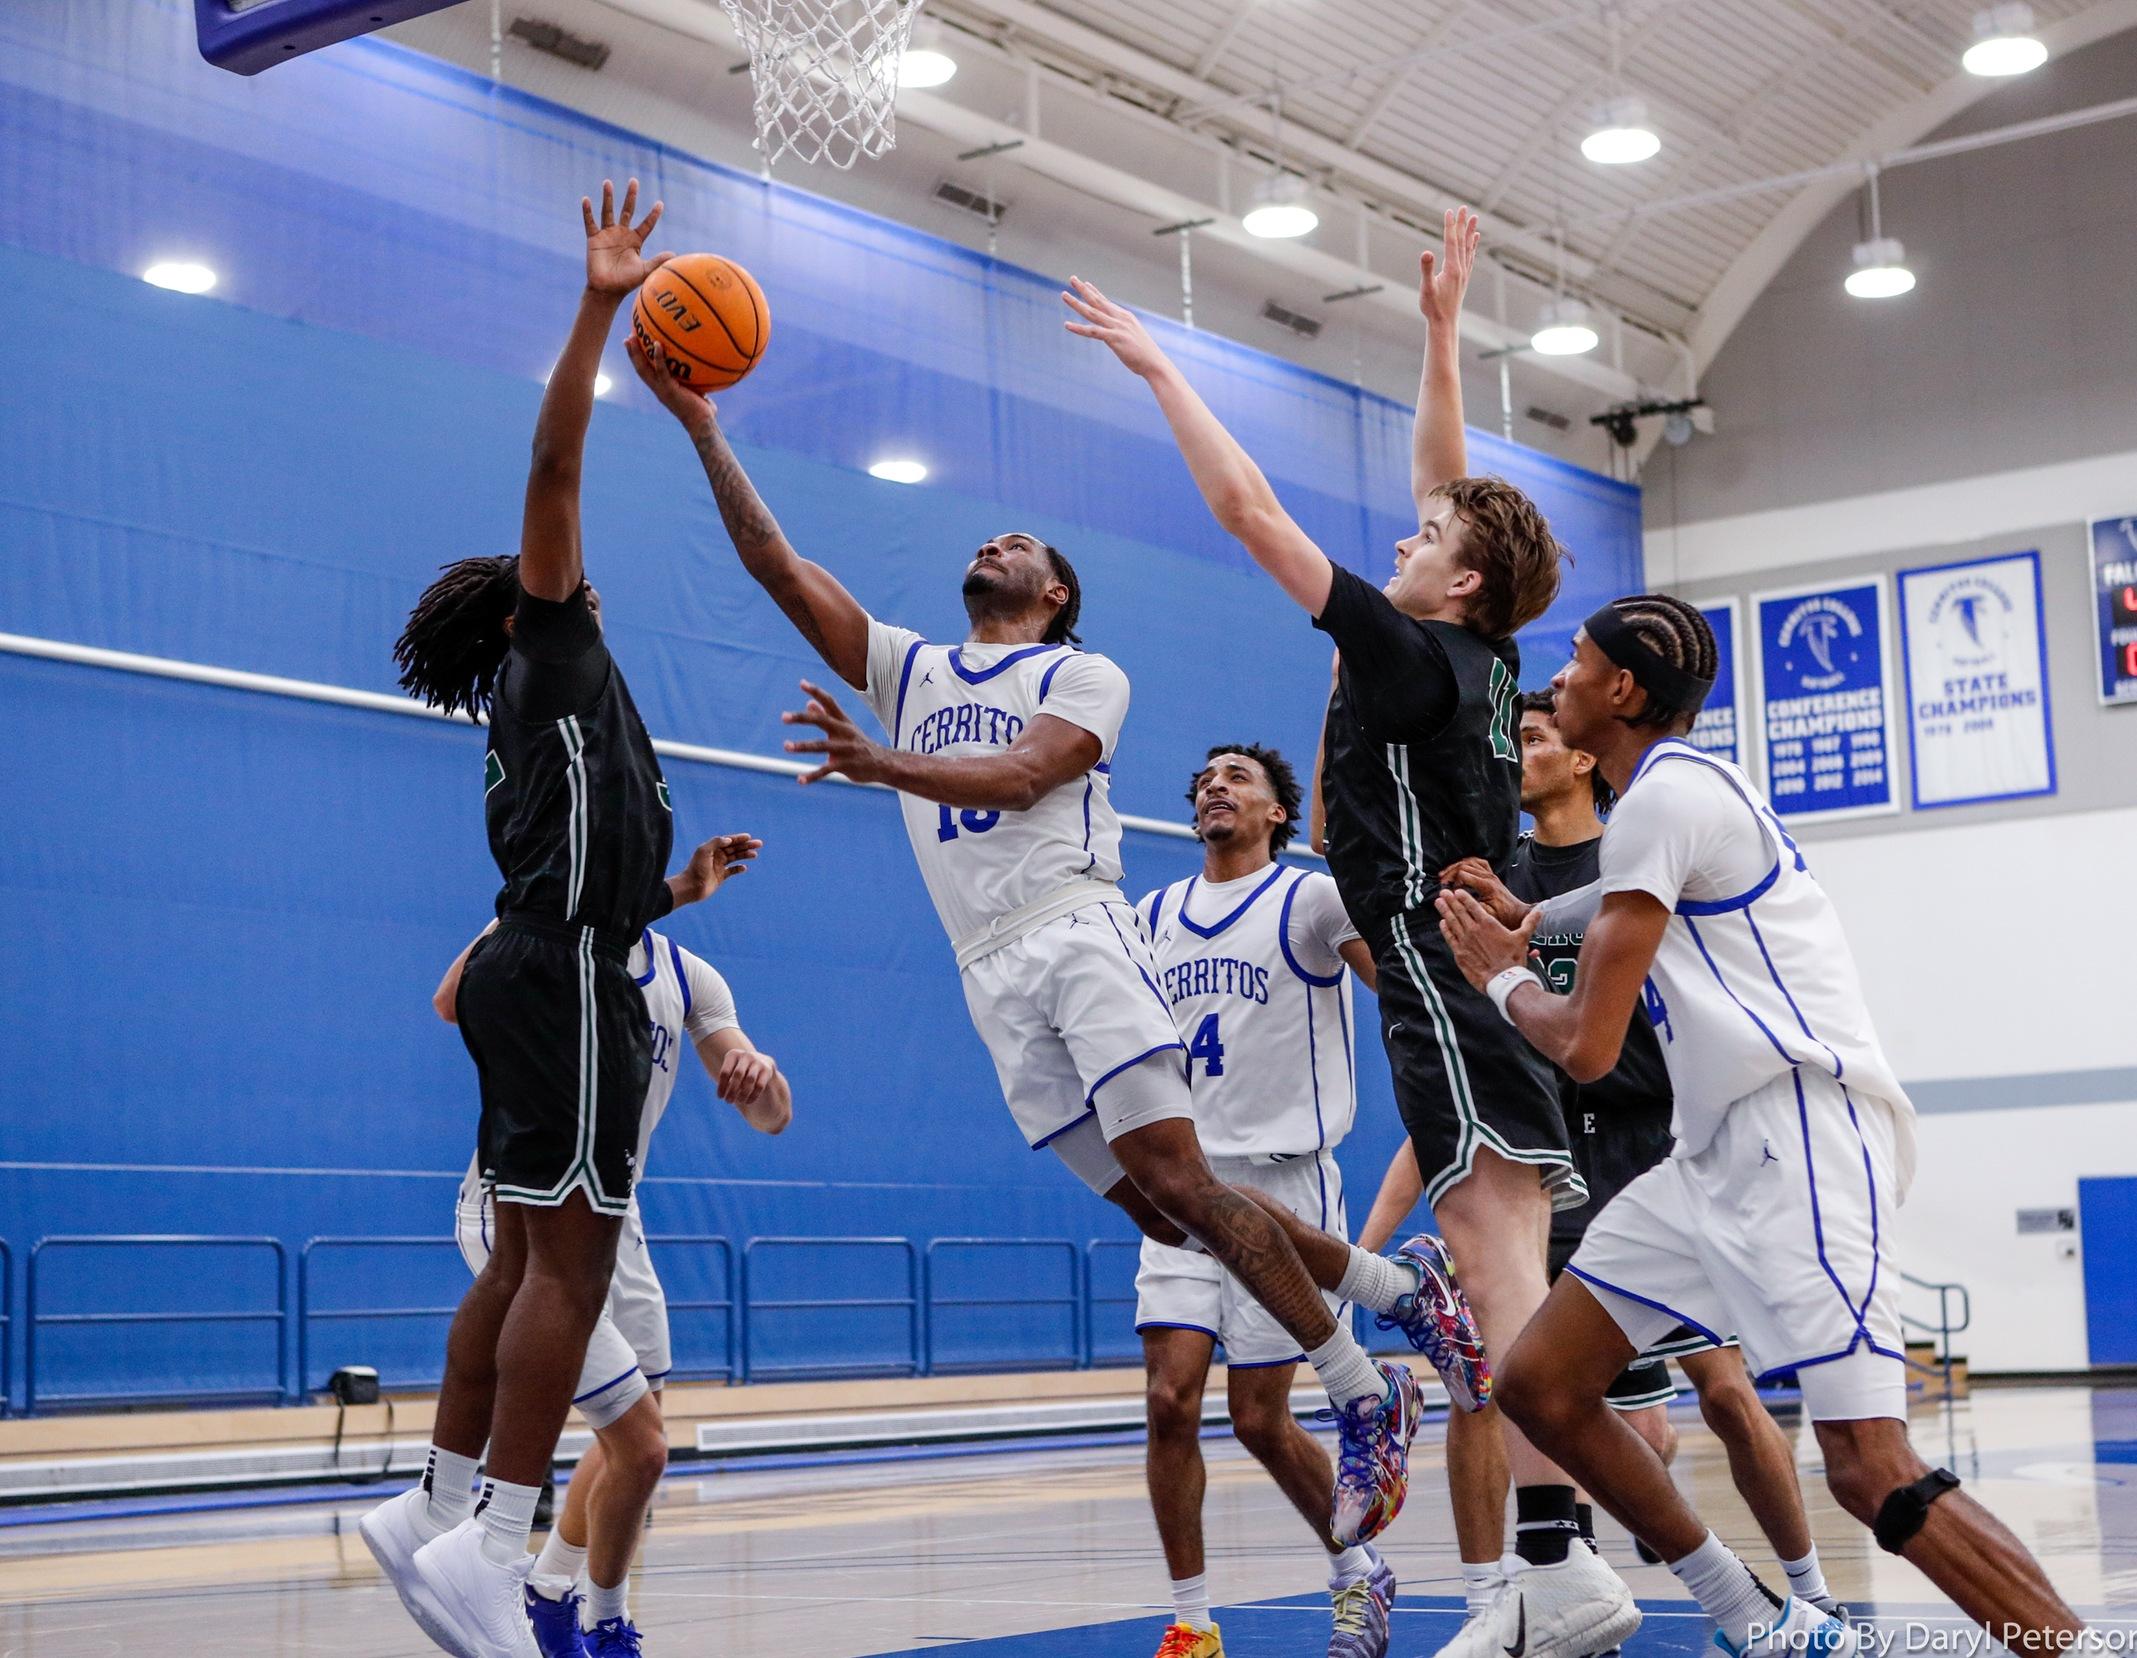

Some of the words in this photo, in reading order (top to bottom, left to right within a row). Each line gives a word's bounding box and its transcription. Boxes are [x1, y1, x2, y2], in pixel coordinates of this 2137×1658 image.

[1943, 671, 2007, 696] STATE
[1767, 686, 1881, 720] CONFERENCE
[1919, 689, 2036, 720] CHAMPIONS
[911, 703, 1023, 754] CERRITO
[1768, 707, 1883, 742] CHAMPIONS
[1164, 957, 1269, 1005] ERRITOS
[1190, 1012, 1224, 1077] 4
[1583, 1113, 1595, 1133] E
